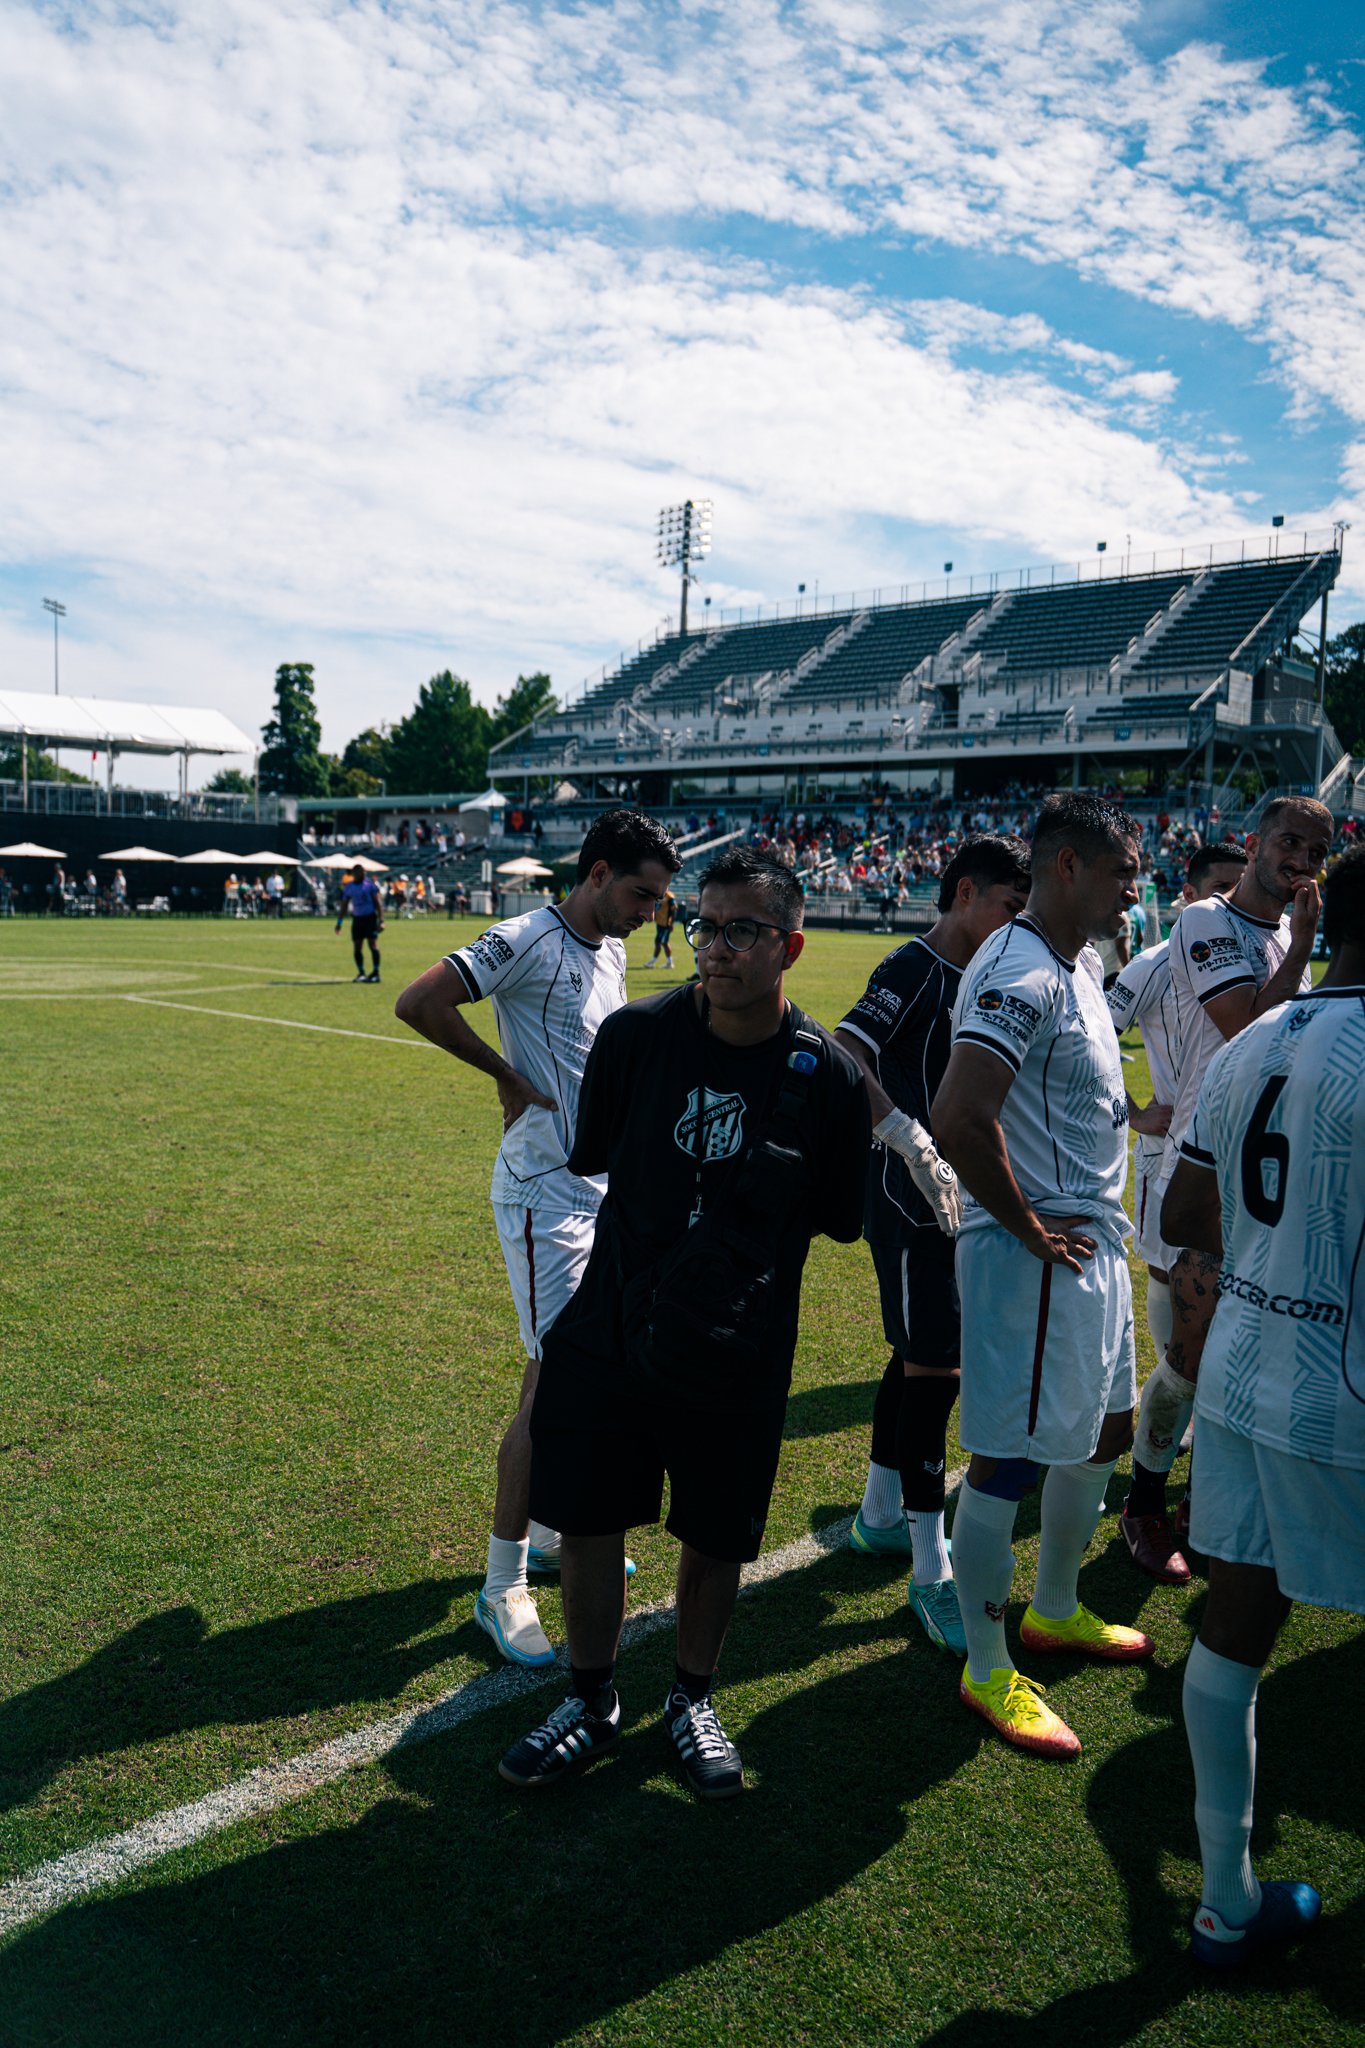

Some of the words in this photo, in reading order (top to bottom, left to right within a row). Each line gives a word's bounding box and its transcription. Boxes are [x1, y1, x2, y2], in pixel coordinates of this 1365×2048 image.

[681, 1115, 708, 1134] SOCCR
[707, 1100, 740, 1119] CENTRAL
[1242, 1075, 1289, 1227] 6
